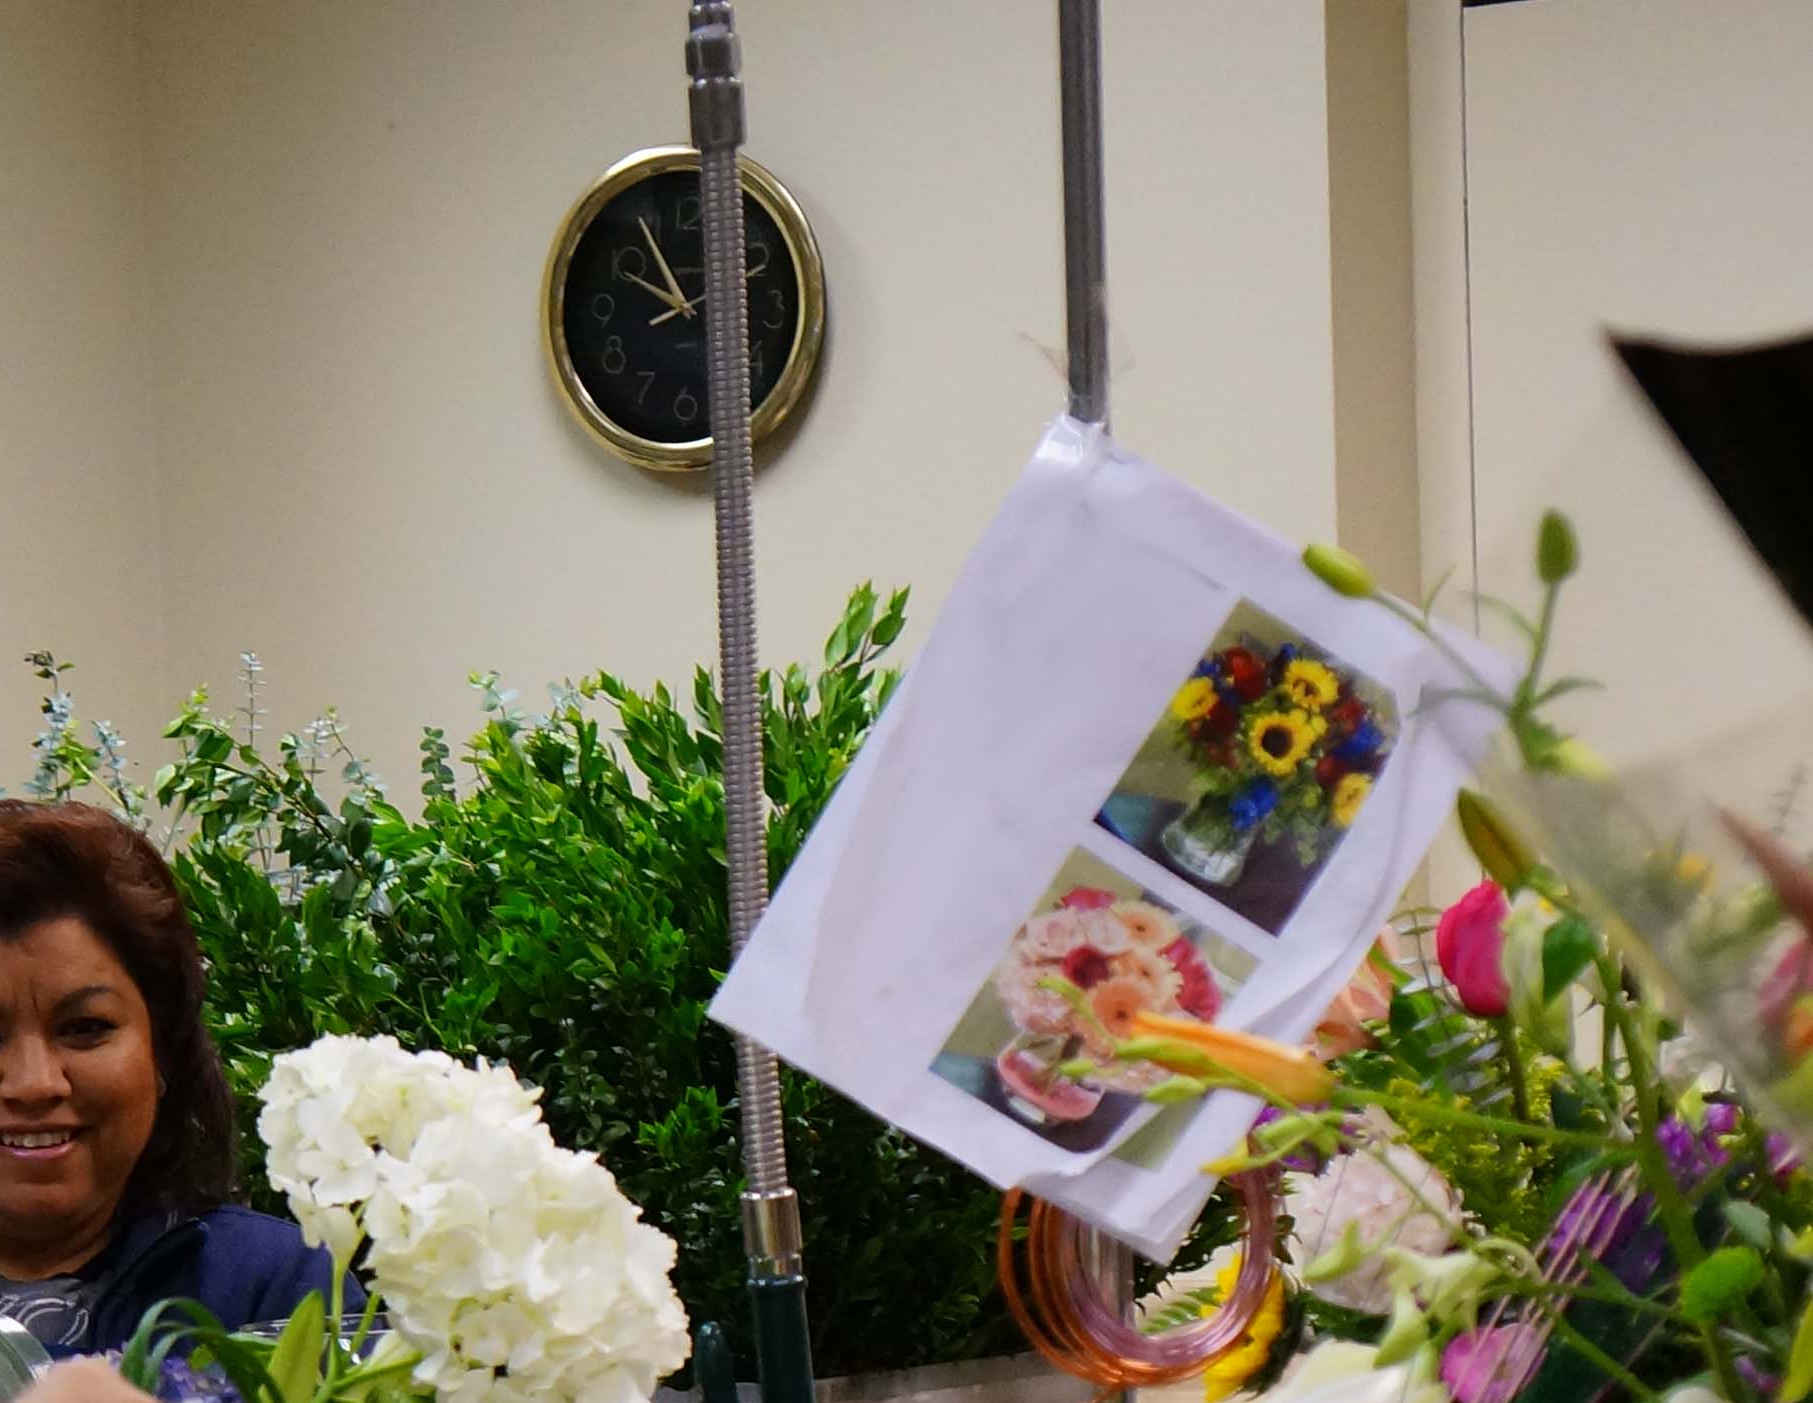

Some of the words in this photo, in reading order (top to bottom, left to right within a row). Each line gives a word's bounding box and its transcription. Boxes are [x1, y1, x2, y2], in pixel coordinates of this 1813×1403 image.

[612, 246, 647, 281] 10
[593, 293, 616, 328] 9
[763, 289, 785, 329] 3
[602, 335, 626, 374] 8
[636, 371, 656, 406] 7
[673, 387, 698, 423] 6
